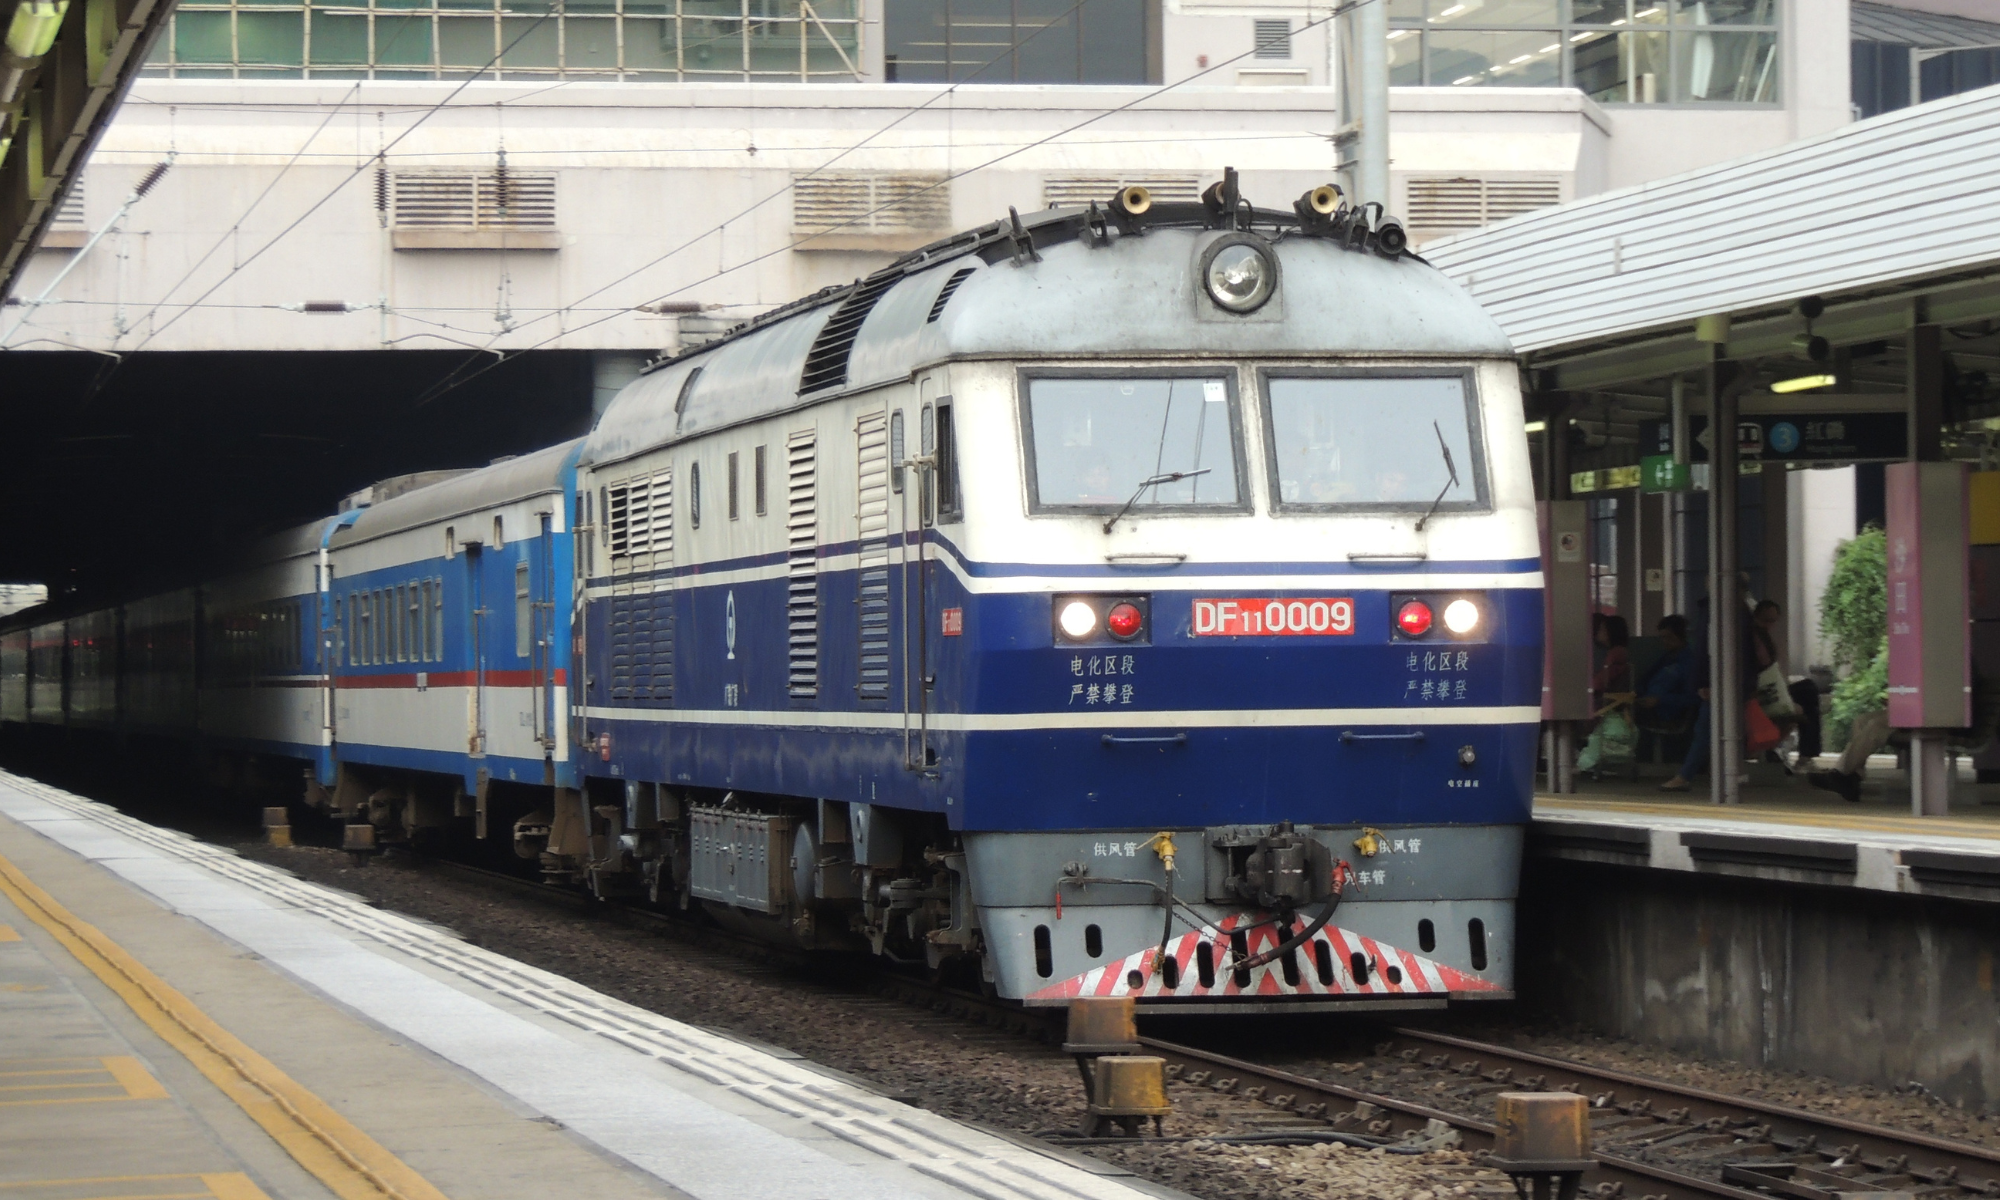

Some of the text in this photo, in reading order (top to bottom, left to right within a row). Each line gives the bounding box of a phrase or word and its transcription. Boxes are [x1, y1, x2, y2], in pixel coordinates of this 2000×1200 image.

[1195, 602, 1351, 632] DF110009
[1071, 655, 1135, 677] 电化区段
[1406, 651, 1469, 672] 电化区段
[1068, 683, 1134, 705] 严禁攀登
[1403, 679, 1467, 701] 严禁攀登
[1094, 841, 1138, 857] 供风管
[1378, 838, 1421, 854] 供风管
